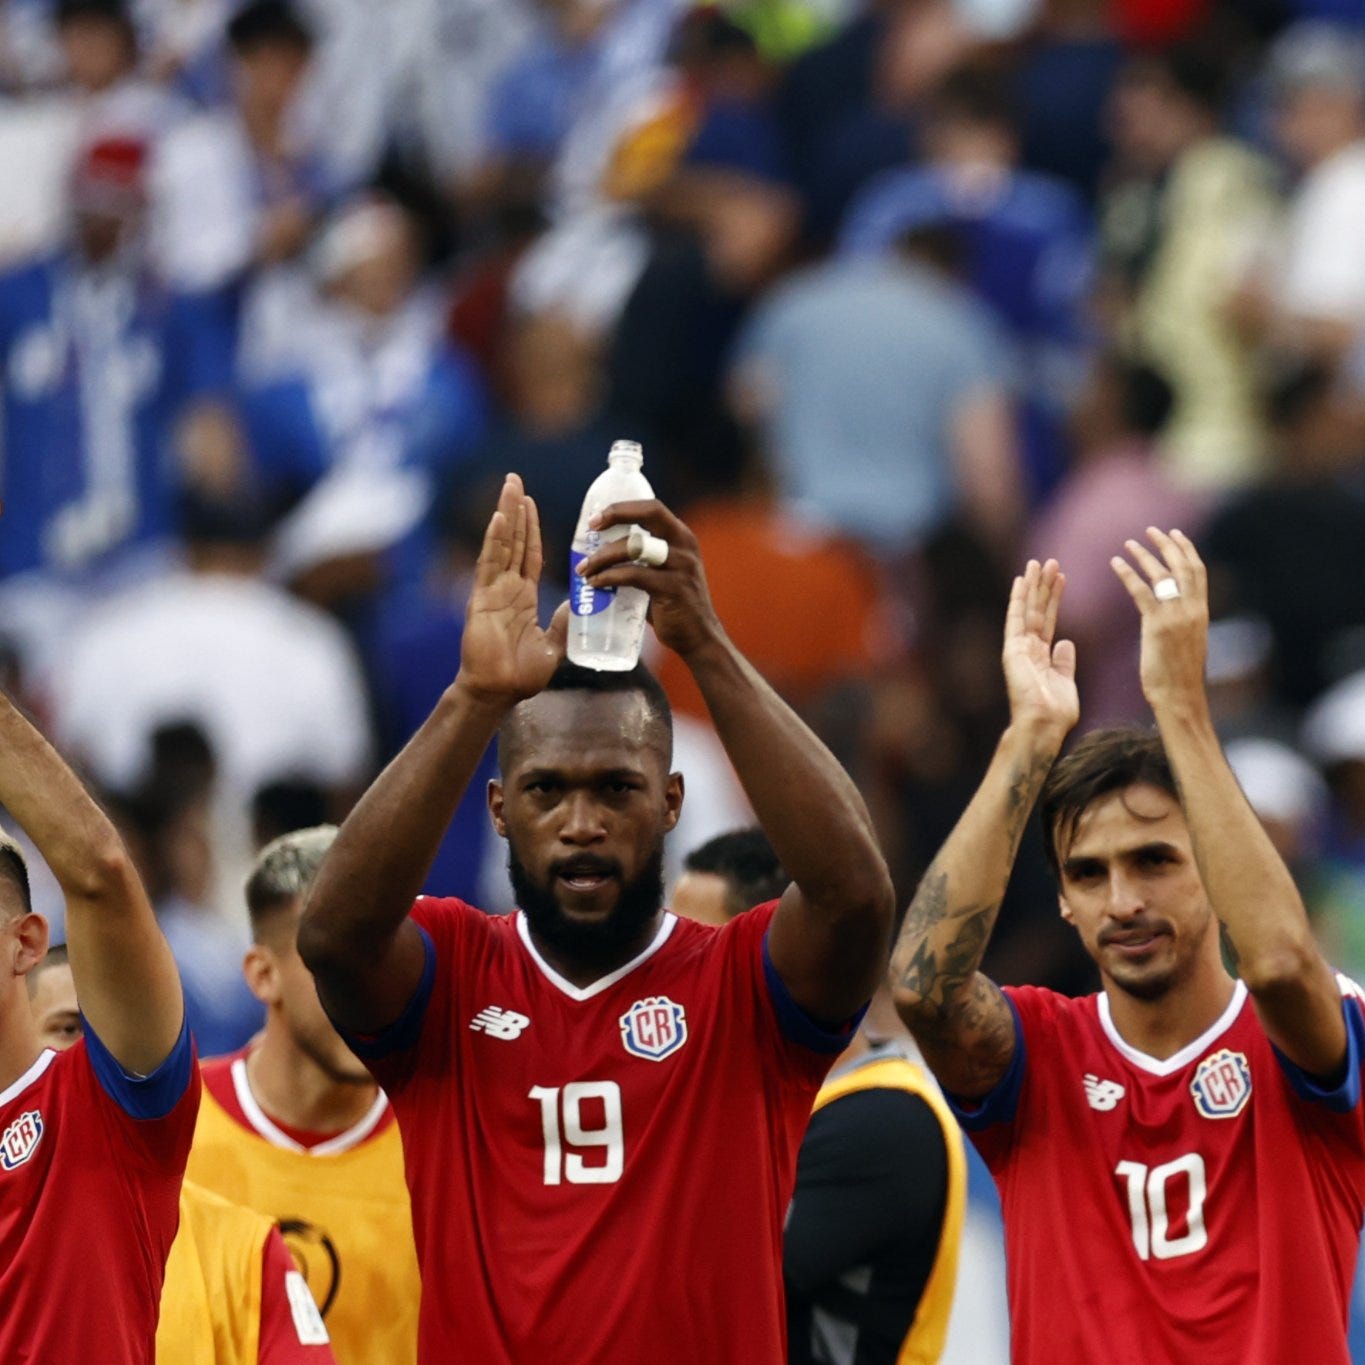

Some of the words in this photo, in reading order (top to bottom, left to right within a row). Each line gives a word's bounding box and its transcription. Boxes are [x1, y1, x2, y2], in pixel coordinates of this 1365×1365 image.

[635, 1009, 673, 1048] CR
[1206, 1062, 1242, 1105] CR
[527, 1080, 624, 1185] 19
[1115, 1152, 1208, 1261] 10
